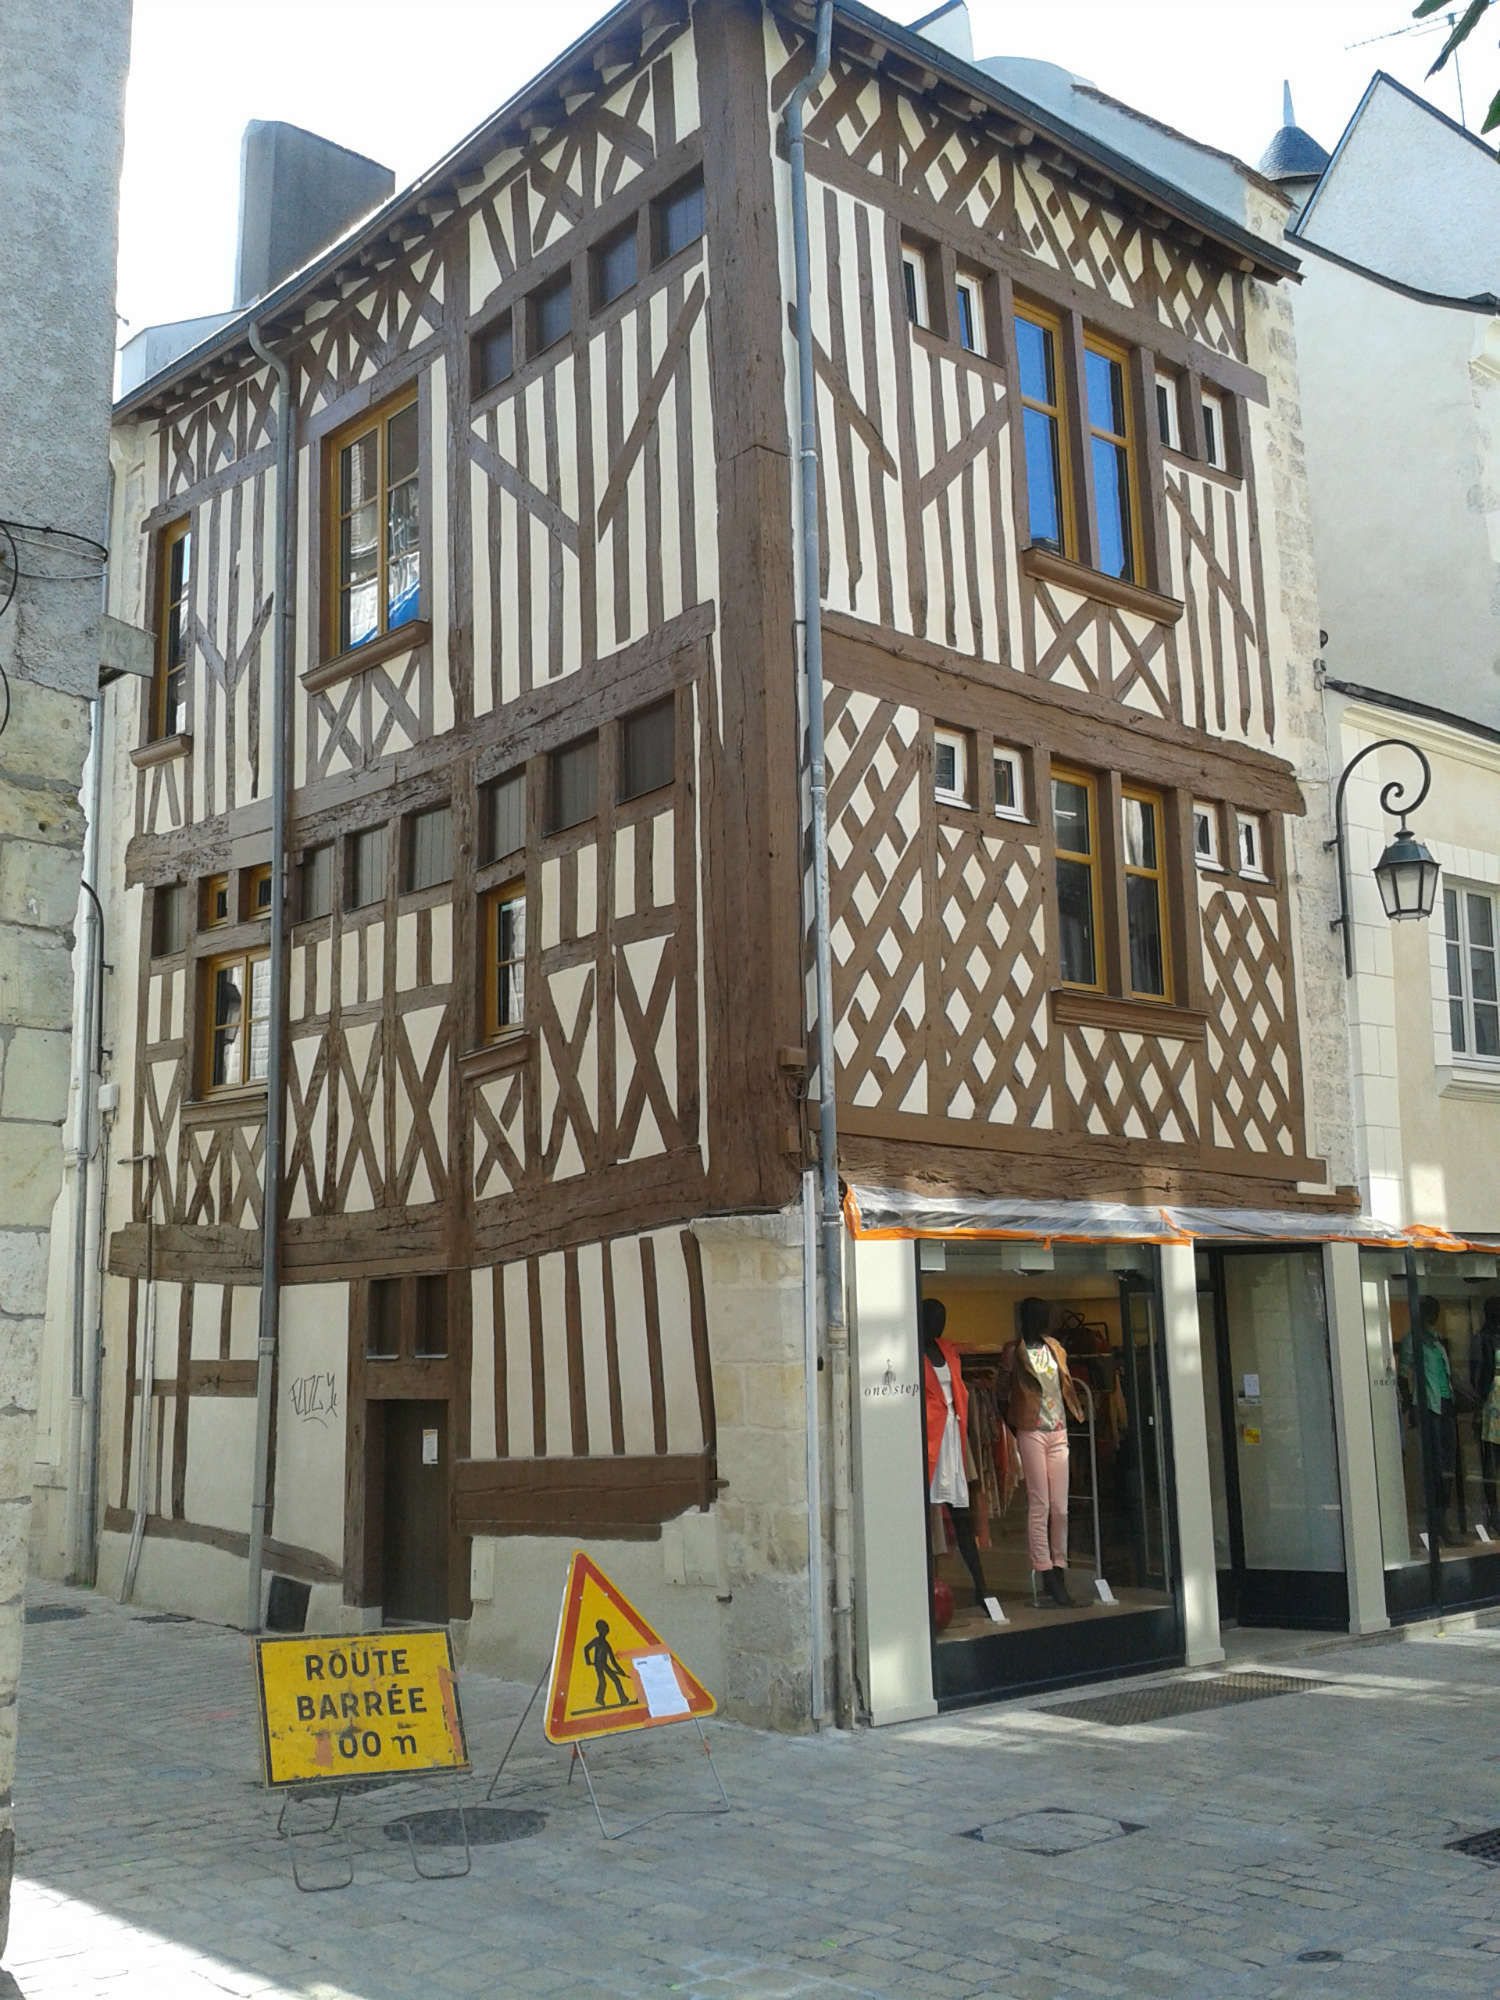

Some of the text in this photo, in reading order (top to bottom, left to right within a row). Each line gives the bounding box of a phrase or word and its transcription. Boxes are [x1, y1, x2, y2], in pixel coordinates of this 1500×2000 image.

[864, 1383, 919, 1397] one step
[305, 1648, 410, 1681] ROUTE
[296, 1683, 427, 1721] BARRÉE
